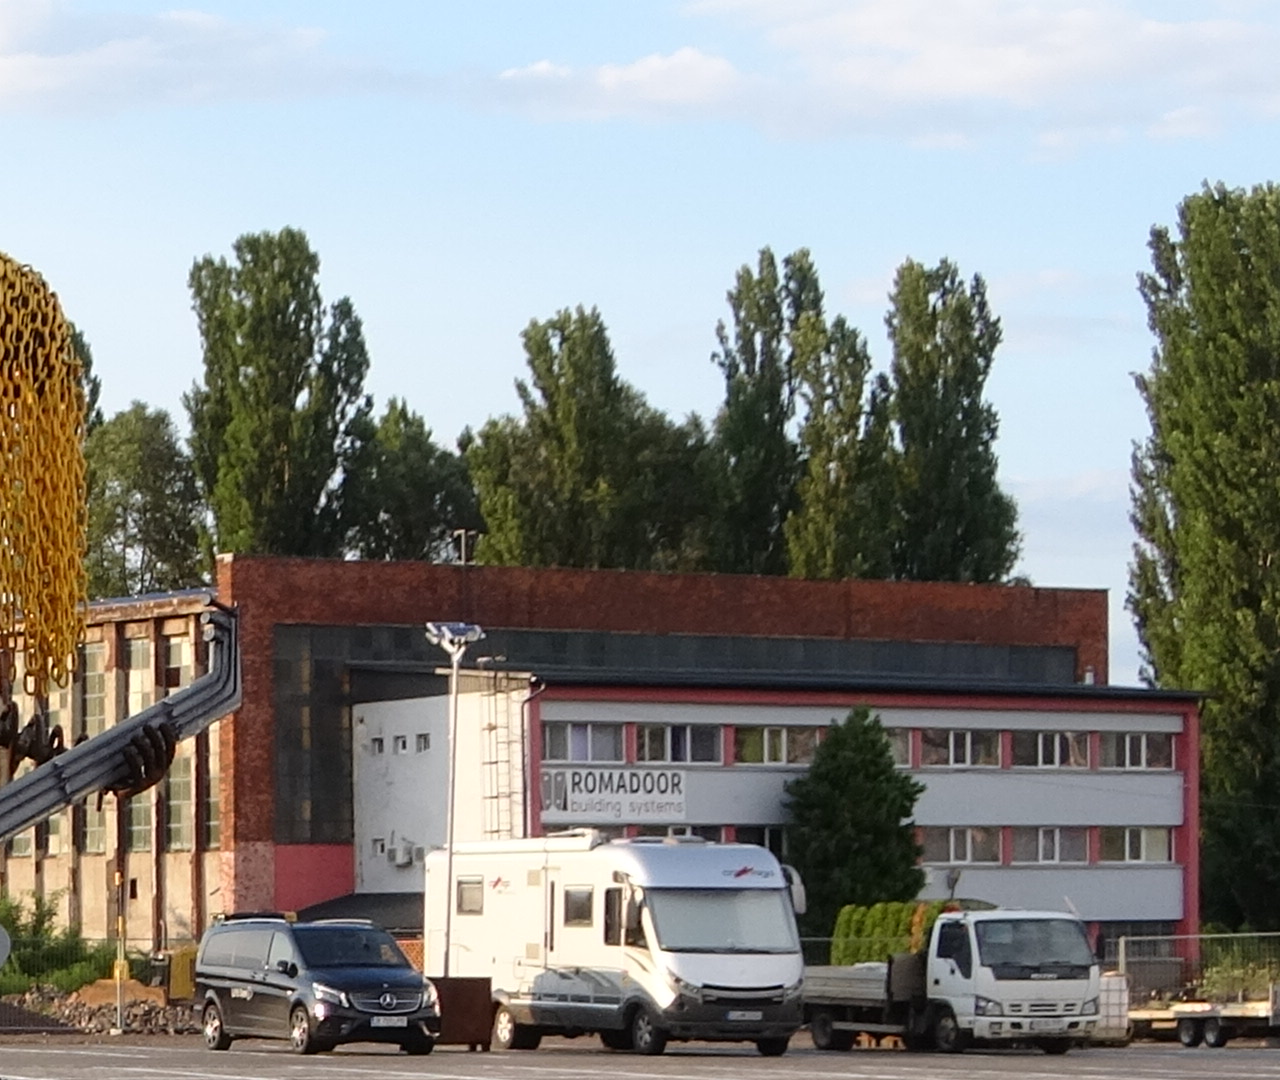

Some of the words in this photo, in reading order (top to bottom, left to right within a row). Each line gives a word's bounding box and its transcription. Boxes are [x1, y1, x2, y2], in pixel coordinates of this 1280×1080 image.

[571, 771, 682, 794] ROMADOOR
[571, 799, 621, 818] building
[628, 801, 683, 816] systems
